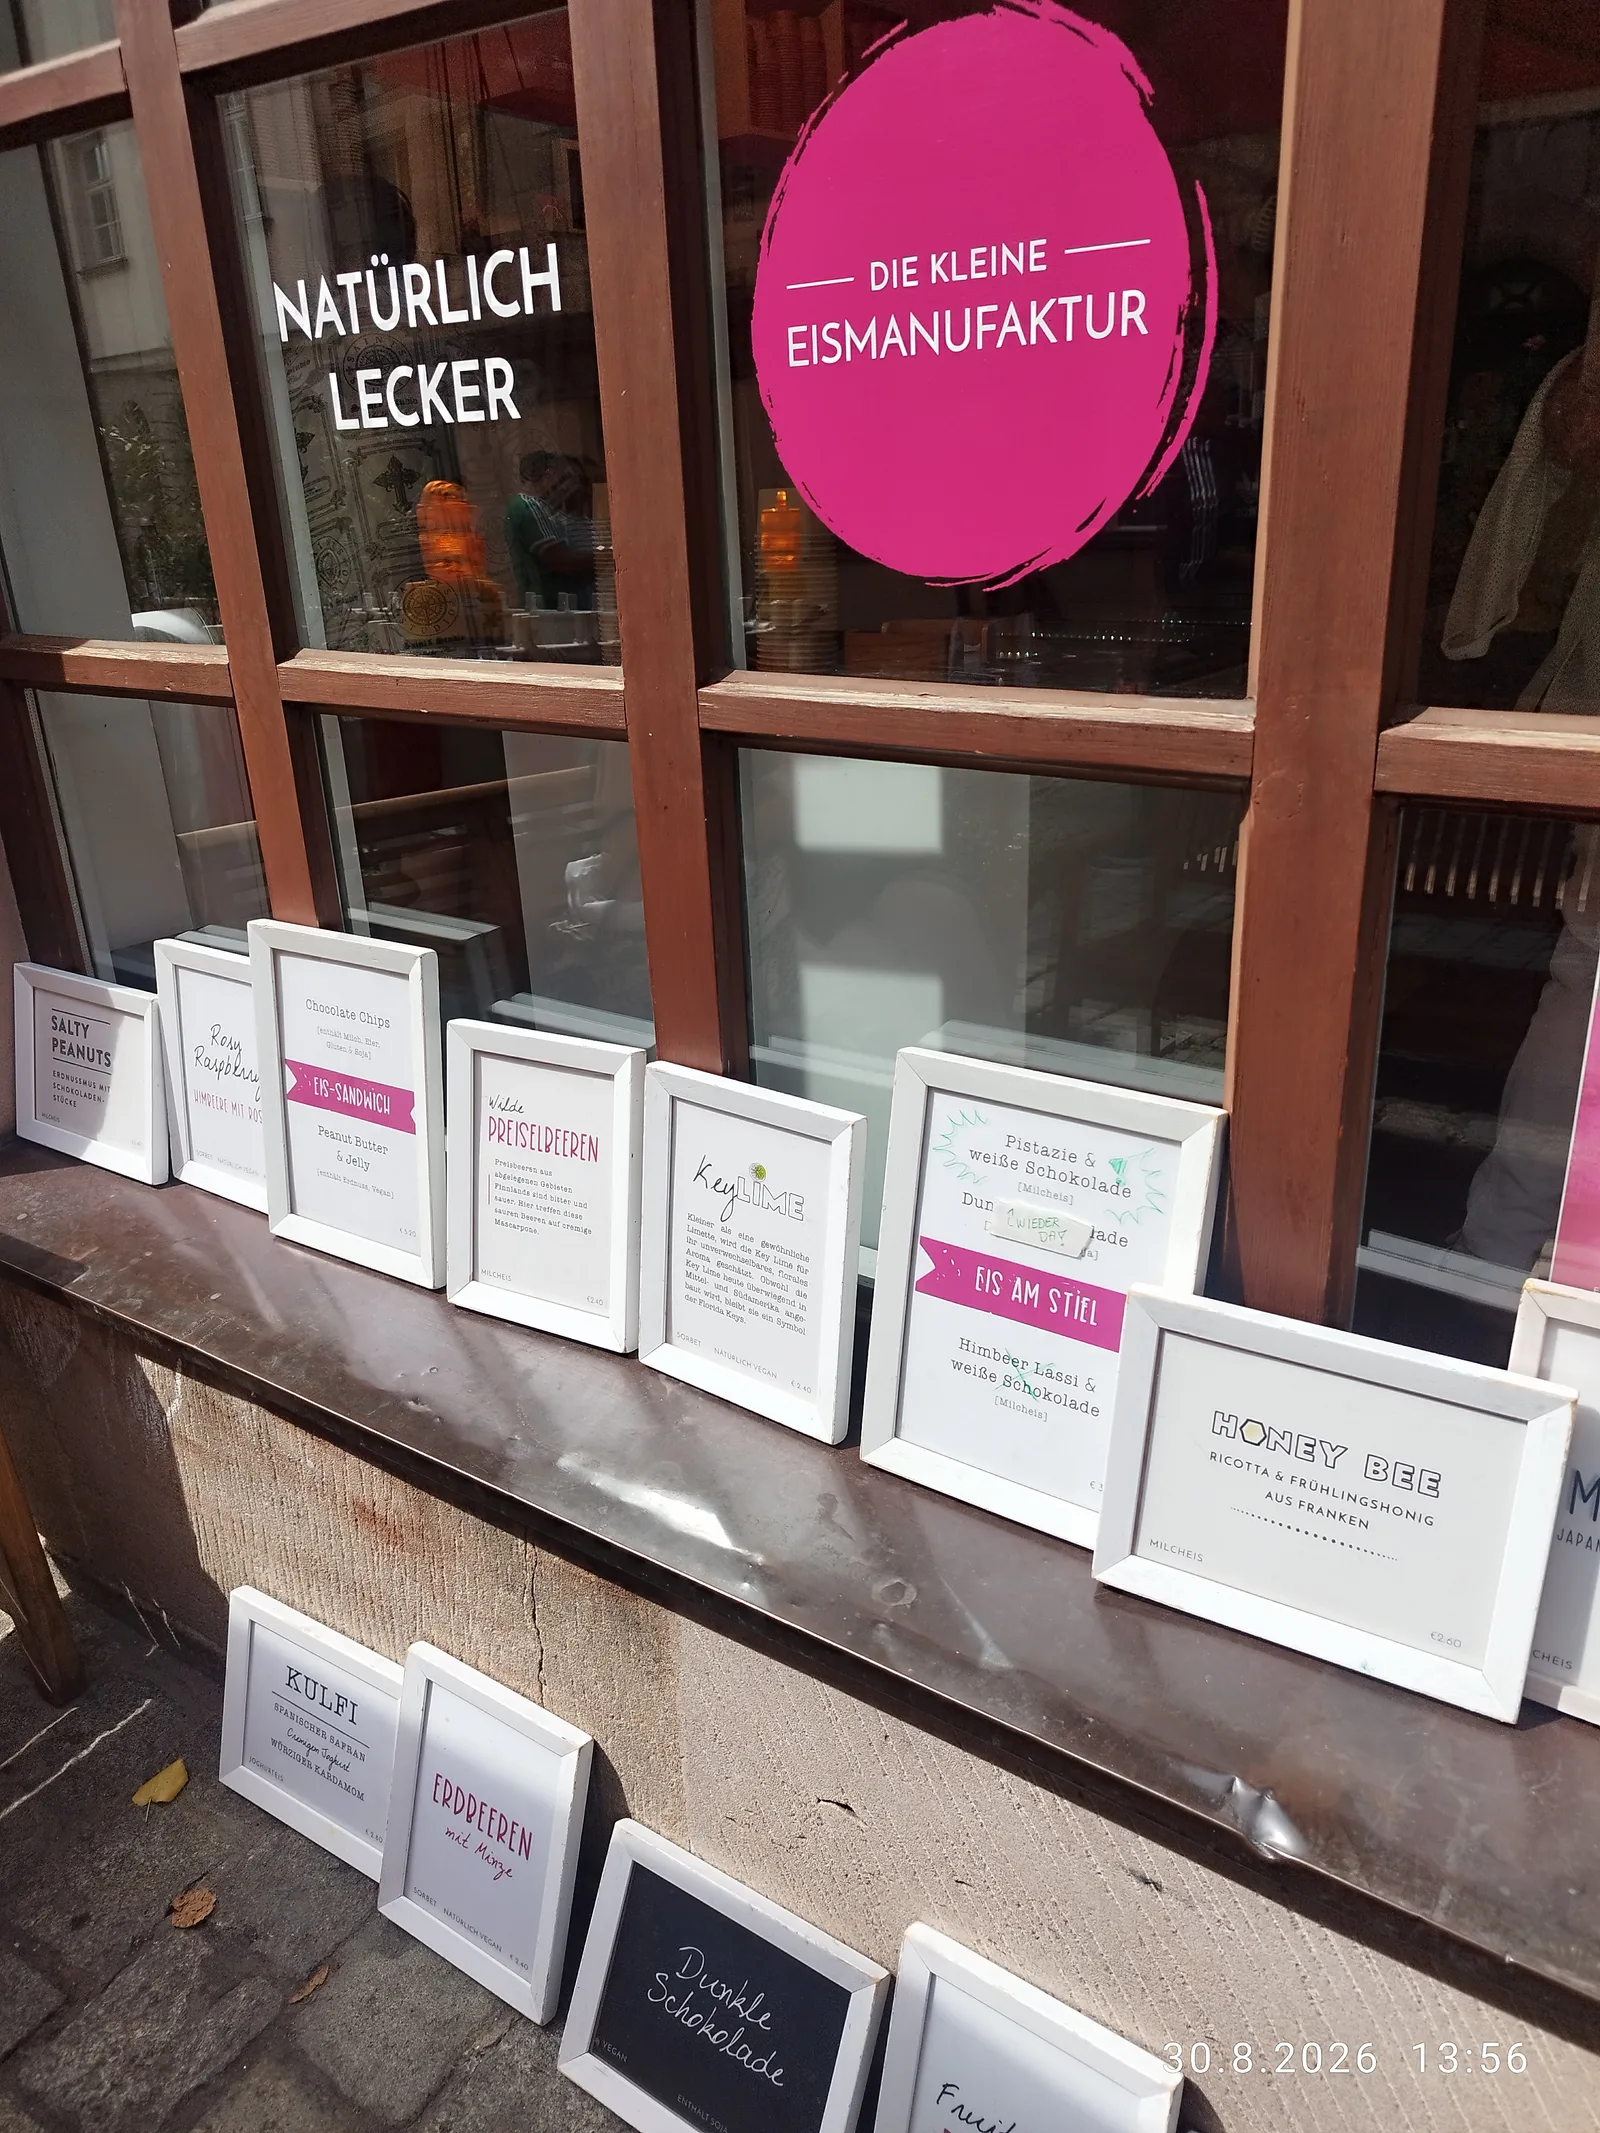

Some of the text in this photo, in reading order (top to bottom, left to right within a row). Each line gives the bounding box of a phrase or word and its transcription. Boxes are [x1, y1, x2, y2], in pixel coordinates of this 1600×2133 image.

[870, 238, 1048, 292] DIE KLEINE
[273, 243, 562, 342] NATÜRLICH
[787, 289, 1149, 367] EISMANUFAKTUR
[328, 356, 522, 431] LECKER
[51, 1015, 89, 1039] SALTY
[305, 998, 391, 1029] Chocolate Chips
[52, 1037, 112, 1068] PEANUTS
[211, 1023, 242, 1055] Rosy
[52, 1070, 111, 1093] ERDNUSSMUS MIT
[52, 1082, 105, 1103] SCHOKOLADEN-
[194, 1045, 260, 1102] Raspberry
[313, 1076, 390, 1115] EIS-SANDWICH
[52, 1094, 77, 1108] STÜCKE
[193, 1088, 263, 1124] HIMBEERE MIT ROS
[488, 1094, 524, 1114] Wilde
[317, 1125, 389, 1155] Peanut Butter
[336, 1150, 371, 1172] & Jelly
[488, 1115, 599, 1163] PREISELBEEREN
[1005, 1134, 1096, 1168] Pistazie &
[494, 1171, 573, 1194] abgelegenen Gebieten
[539, 1168, 553, 1177] aus
[969, 1149, 1132, 1199] weiße Schokolade
[1017, 1181, 1074, 1206] [Milcheis]
[494, 1182, 588, 1210] Finnlands sind bitter und
[518, 1199, 534, 1209] Hier
[536, 1204, 562, 1216] treffen
[563, 1209, 584, 1221] diese
[494, 1207, 593, 1236] sauren Beeren auf cremige
[494, 1218, 541, 1235] Mascarpone.
[687, 1213, 810, 1264] Kleiner als eine gewöhnliche
[962, 1191, 1129, 1248] Dun lade
[1016, 1216, 1061, 1230] WIEDER
[686, 1224, 810, 1276] Limette, wird die Key Lime für
[686, 1236, 809, 1288] ihr unverwechselbares, florales
[481, 1268, 512, 1282] MILCHEIS
[685, 1248, 808, 1300] Aroma geschätzt. Obwohl die
[685, 1259, 807, 1312] Key Lime heute überwiegend in
[975, 1265, 1098, 1327] EIS AM STIEL
[684, 1281, 806, 1336] baut wird, bleibt sie ein Symbol
[684, 1293, 747, 1325] der Florida Keys.
[685, 1270, 807, 1323] Mittel- und Südamerika ange-
[676, 1331, 702, 1347] SORBET
[752, 1363, 778, 1379] VEGAN
[958, 1336, 1096, 1393] Himbeer Lassi &
[951, 1359, 1100, 1418] weiße Schokolade
[994, 1395, 1049, 1423] [Milcheis]
[1211, 1410, 1442, 1499] HONEY BEE
[1209, 1451, 1435, 1527] RICOTTA & FRÜHLINGSHONIG
[1264, 1490, 1370, 1530] AUS FRANKEN
[1569, 1469, 1600, 1523] M
[1148, 1538, 1205, 1563] MILCHEIS
[1556, 1527, 1600, 1553] JAPAN
[1430, 1630, 1462, 1648] €2.60
[1532, 1649, 1573, 1671] CHEIS
[285, 1665, 359, 1726] KULFI
[273, 1702, 366, 1763] SPANISCHER SAFRAN
[270, 1737, 366, 1803] WÜRZIGER KARDAMOM
[432, 1772, 533, 1862] ERDBEEREN
[444, 1826, 514, 1881] mit Minze
[413, 1886, 438, 1908] SORBET
[478, 1932, 503, 1953] VEGAN
[675, 1946, 772, 2031] Dunkle
[647, 1972, 784, 2087] Schokolade
[602, 2042, 628, 2063] VEGAN
